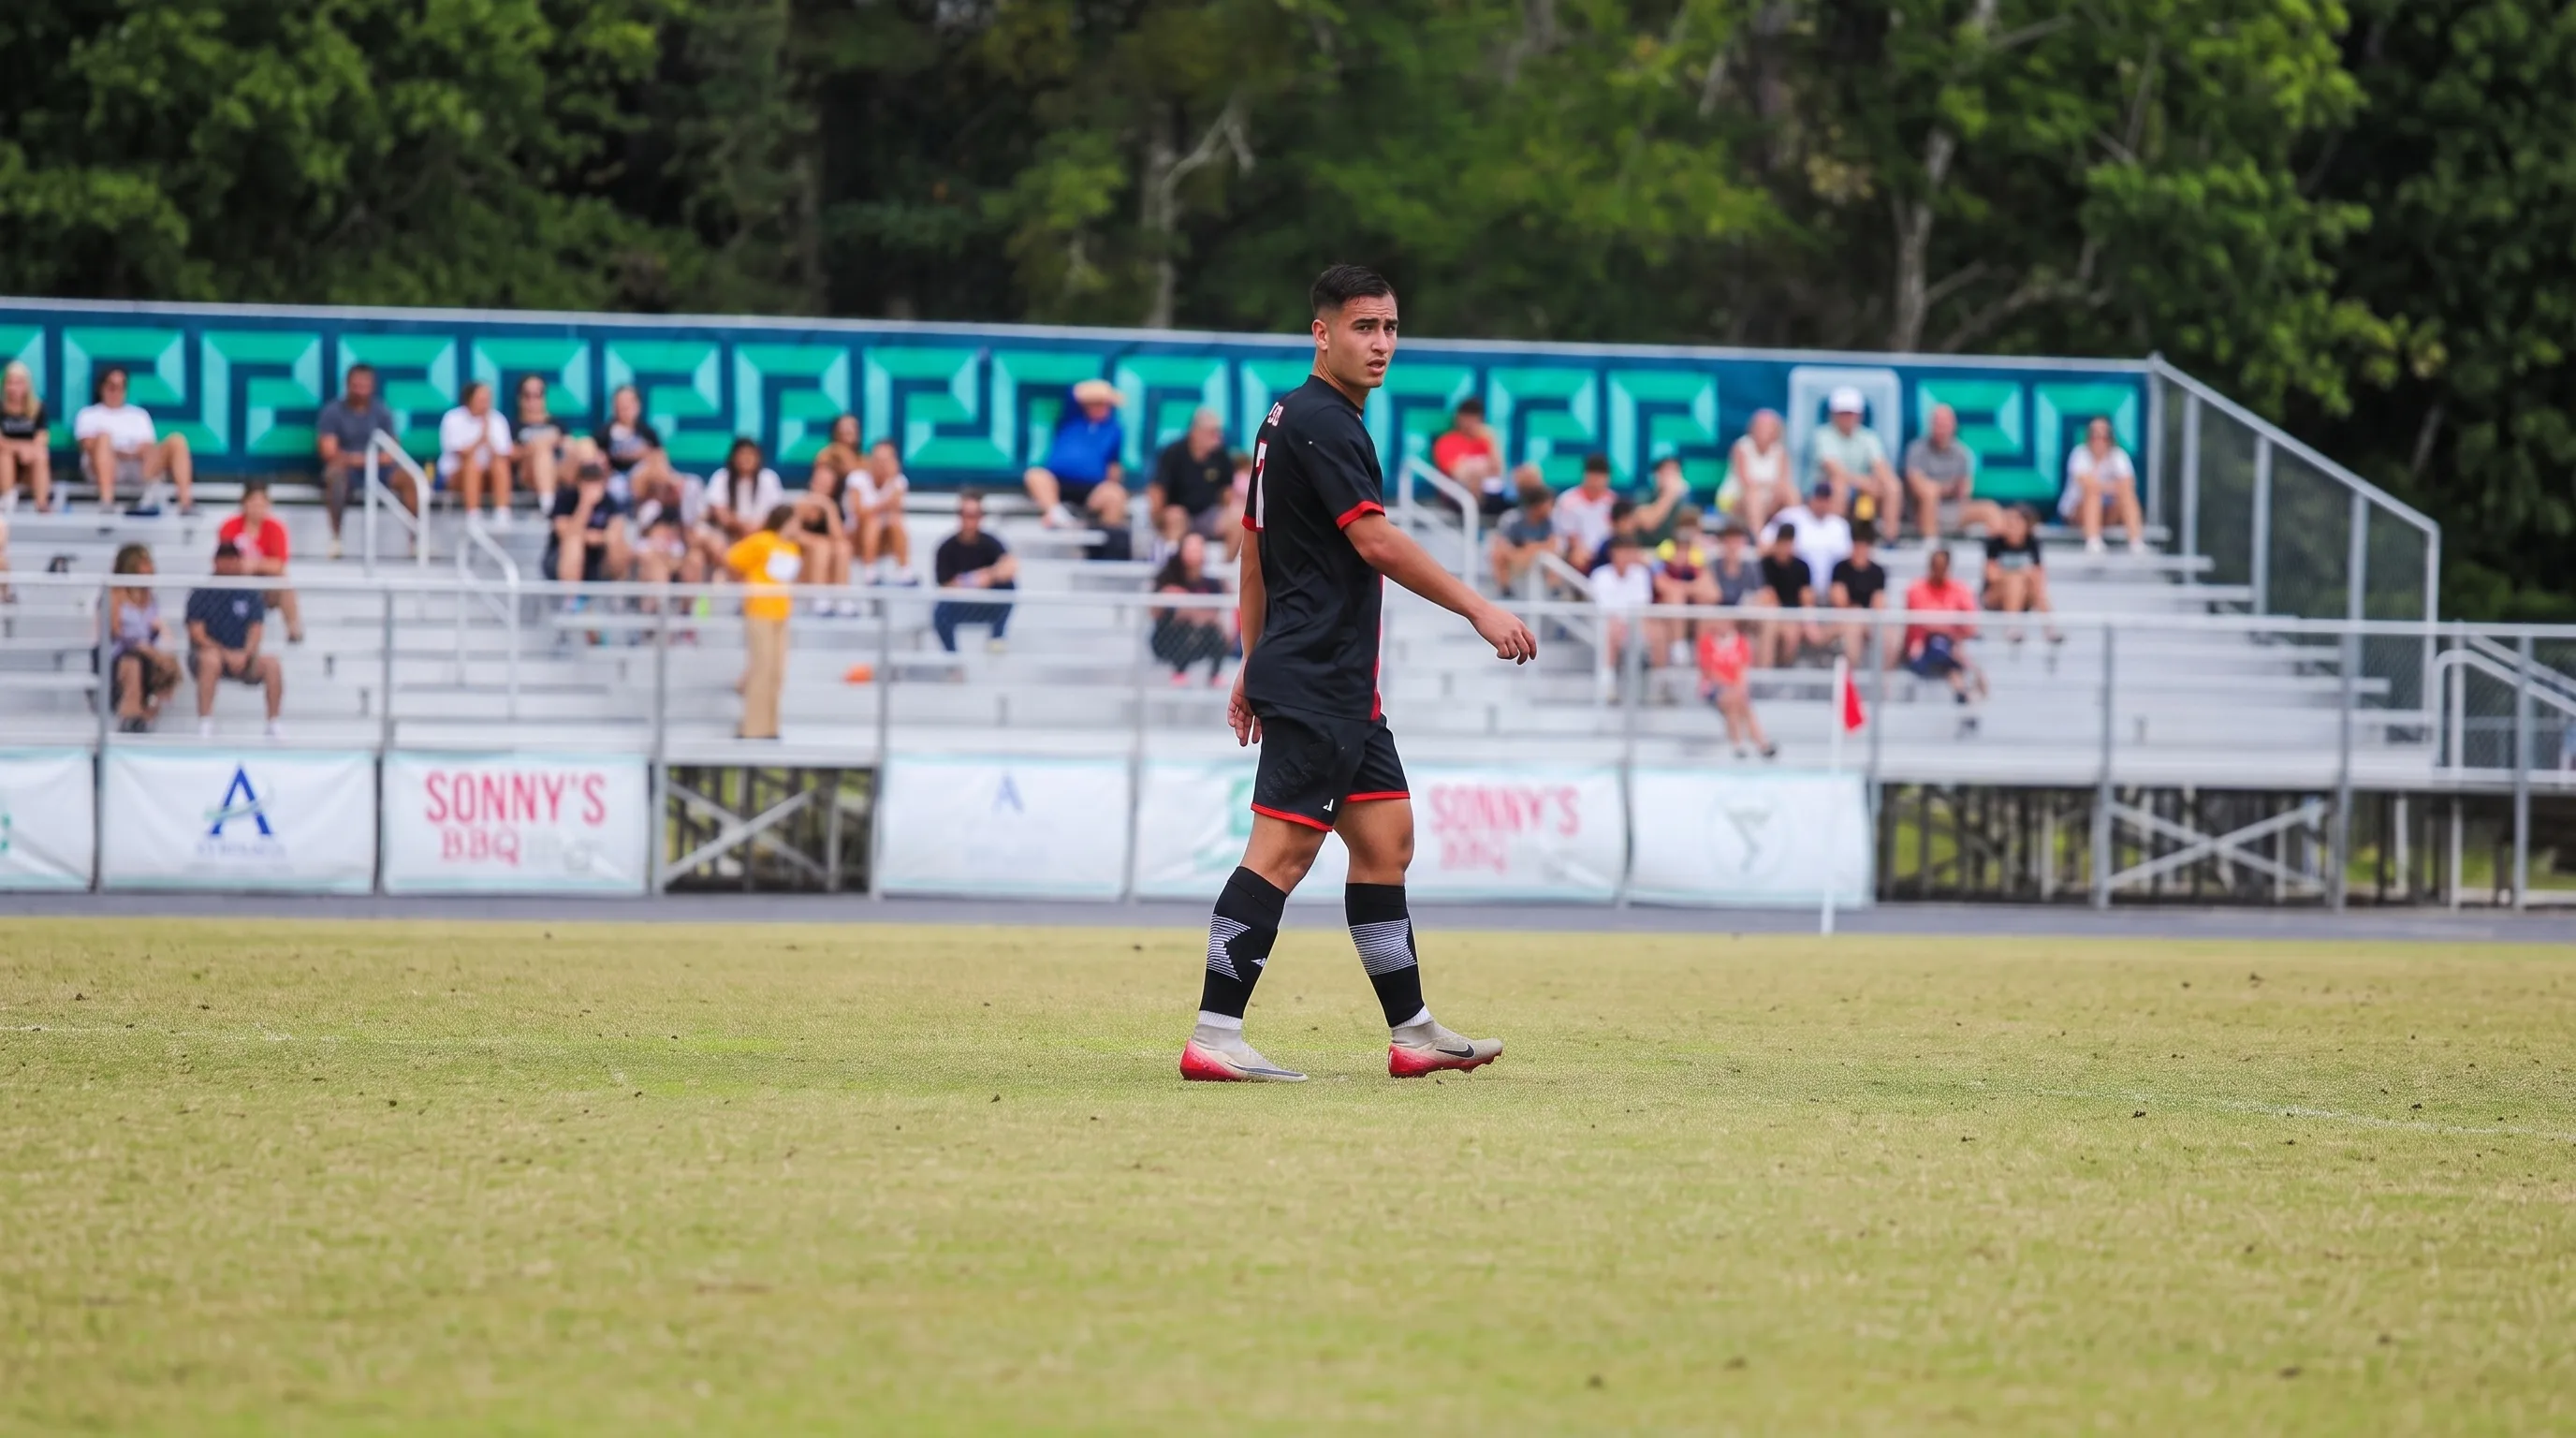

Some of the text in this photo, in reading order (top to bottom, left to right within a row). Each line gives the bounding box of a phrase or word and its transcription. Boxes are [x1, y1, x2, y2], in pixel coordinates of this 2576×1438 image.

[208, 762, 275, 837] A
[425, 770, 607, 826] SONNY'S
[1428, 783, 1581, 836] SONNY'S
[441, 829, 520, 866] BBQ
